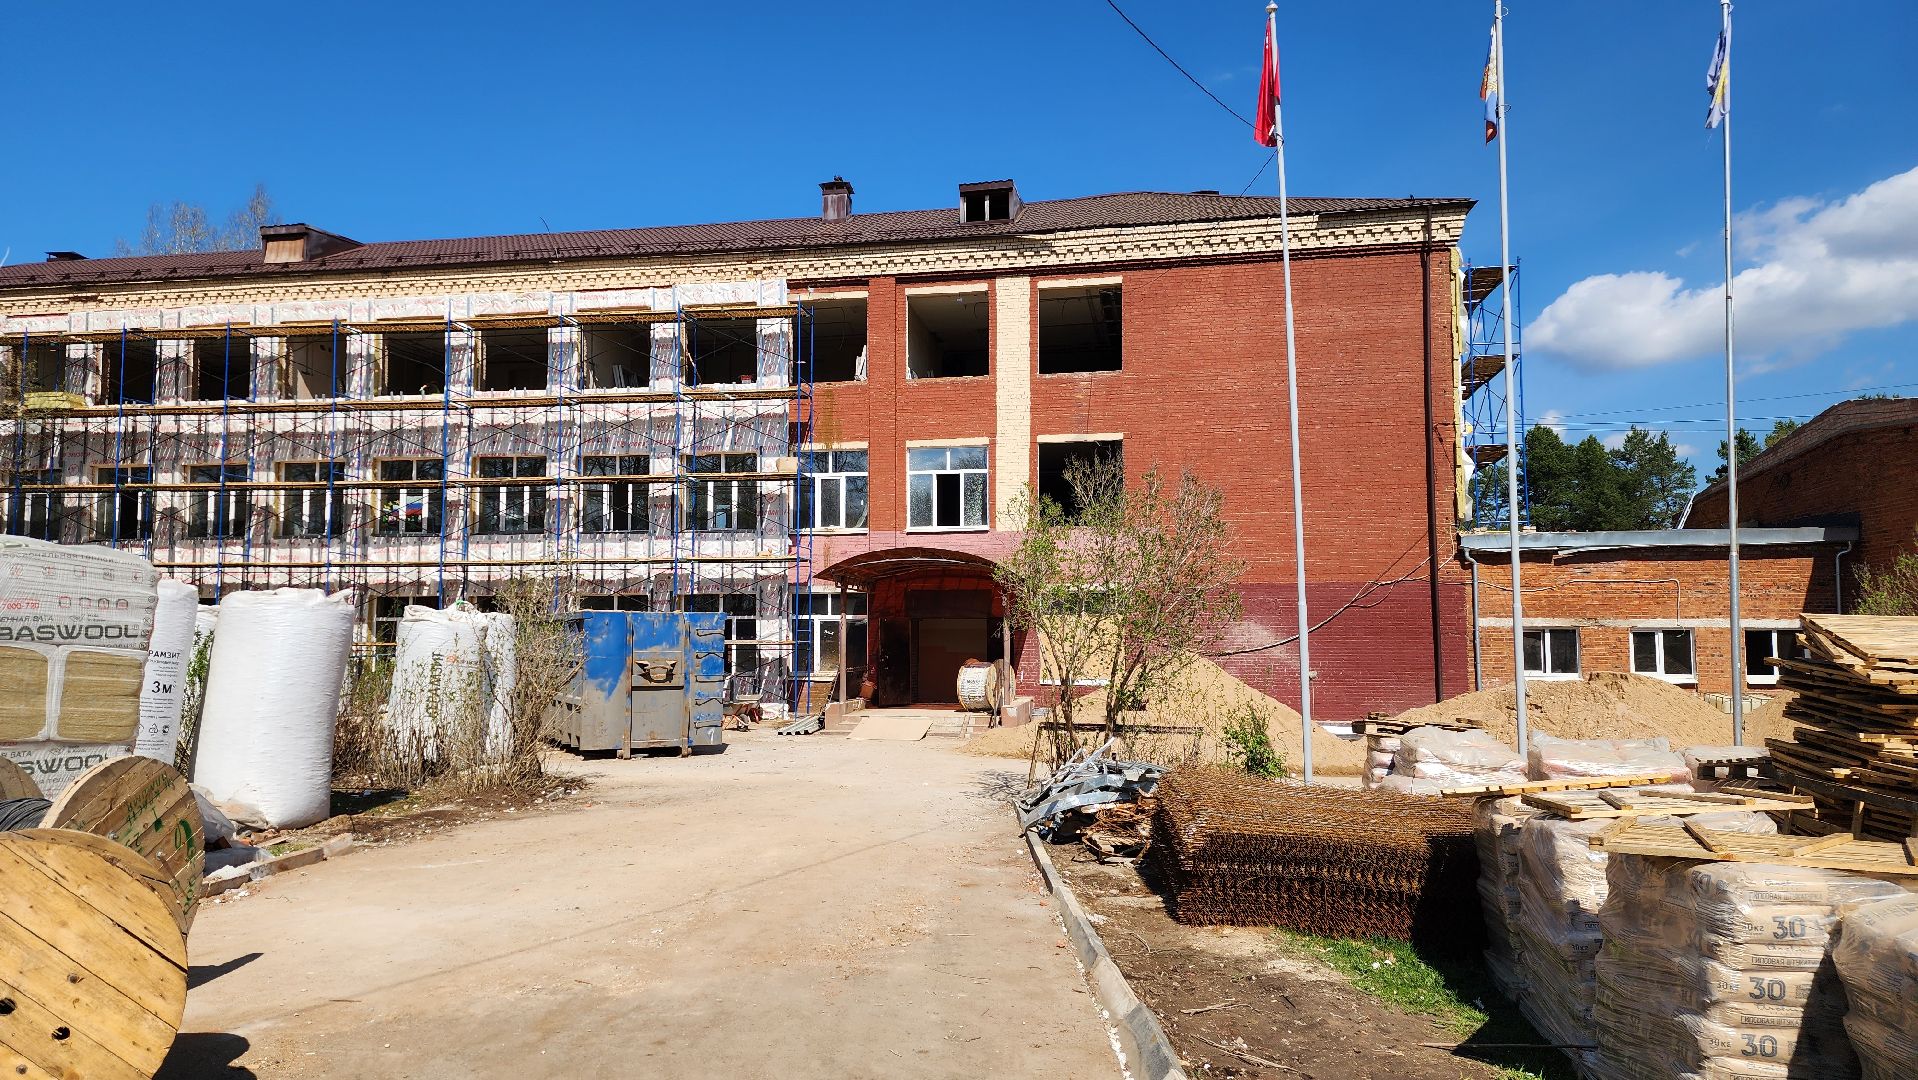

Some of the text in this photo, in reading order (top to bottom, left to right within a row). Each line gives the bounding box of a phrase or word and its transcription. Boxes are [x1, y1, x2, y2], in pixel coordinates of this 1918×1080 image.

[18, 754, 108, 775] SWOO
[1772, 916, 1806, 940] 30
[1749, 976, 1786, 1001] 30
[1740, 1033, 1778, 1058] 30
